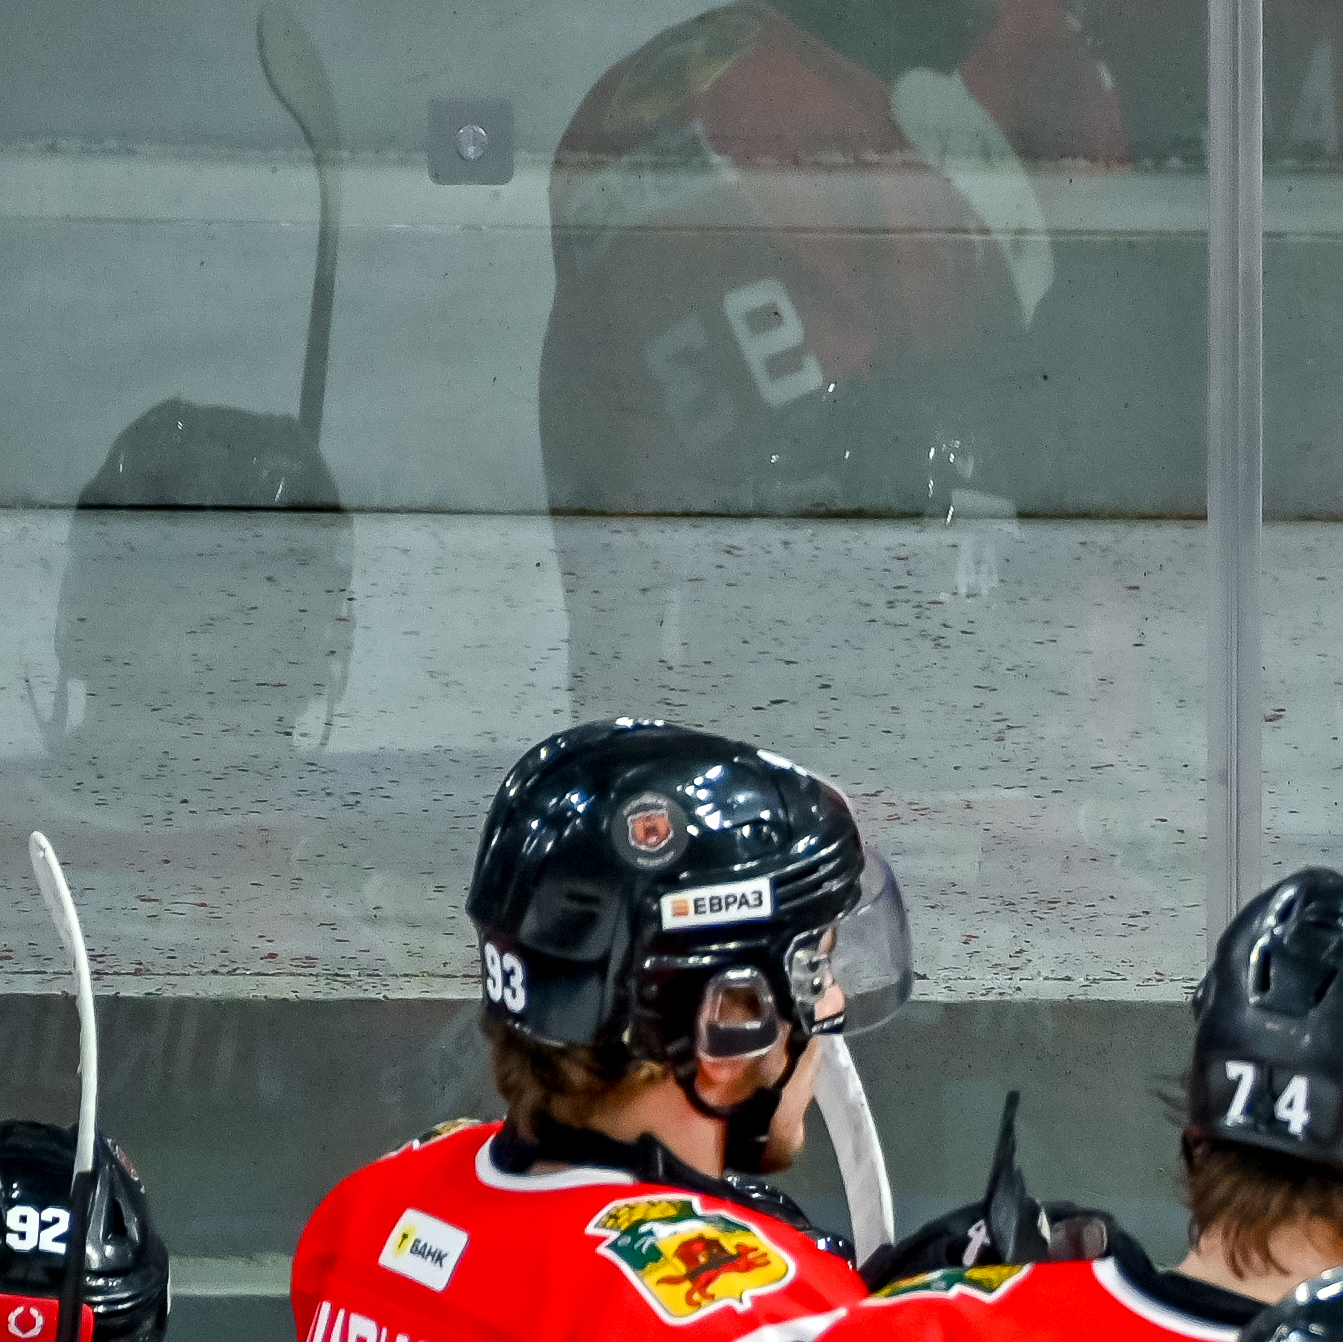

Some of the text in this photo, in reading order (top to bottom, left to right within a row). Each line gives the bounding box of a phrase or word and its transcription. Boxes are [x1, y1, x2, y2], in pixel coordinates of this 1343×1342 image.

[693, 889, 764, 916] ЕВРАЗ
[484, 942, 525, 1013] 93
[1226, 1061, 1311, 1136] 74
[6, 1204, 70, 1255] 92
[409, 1237, 448, 1268] БАНК
